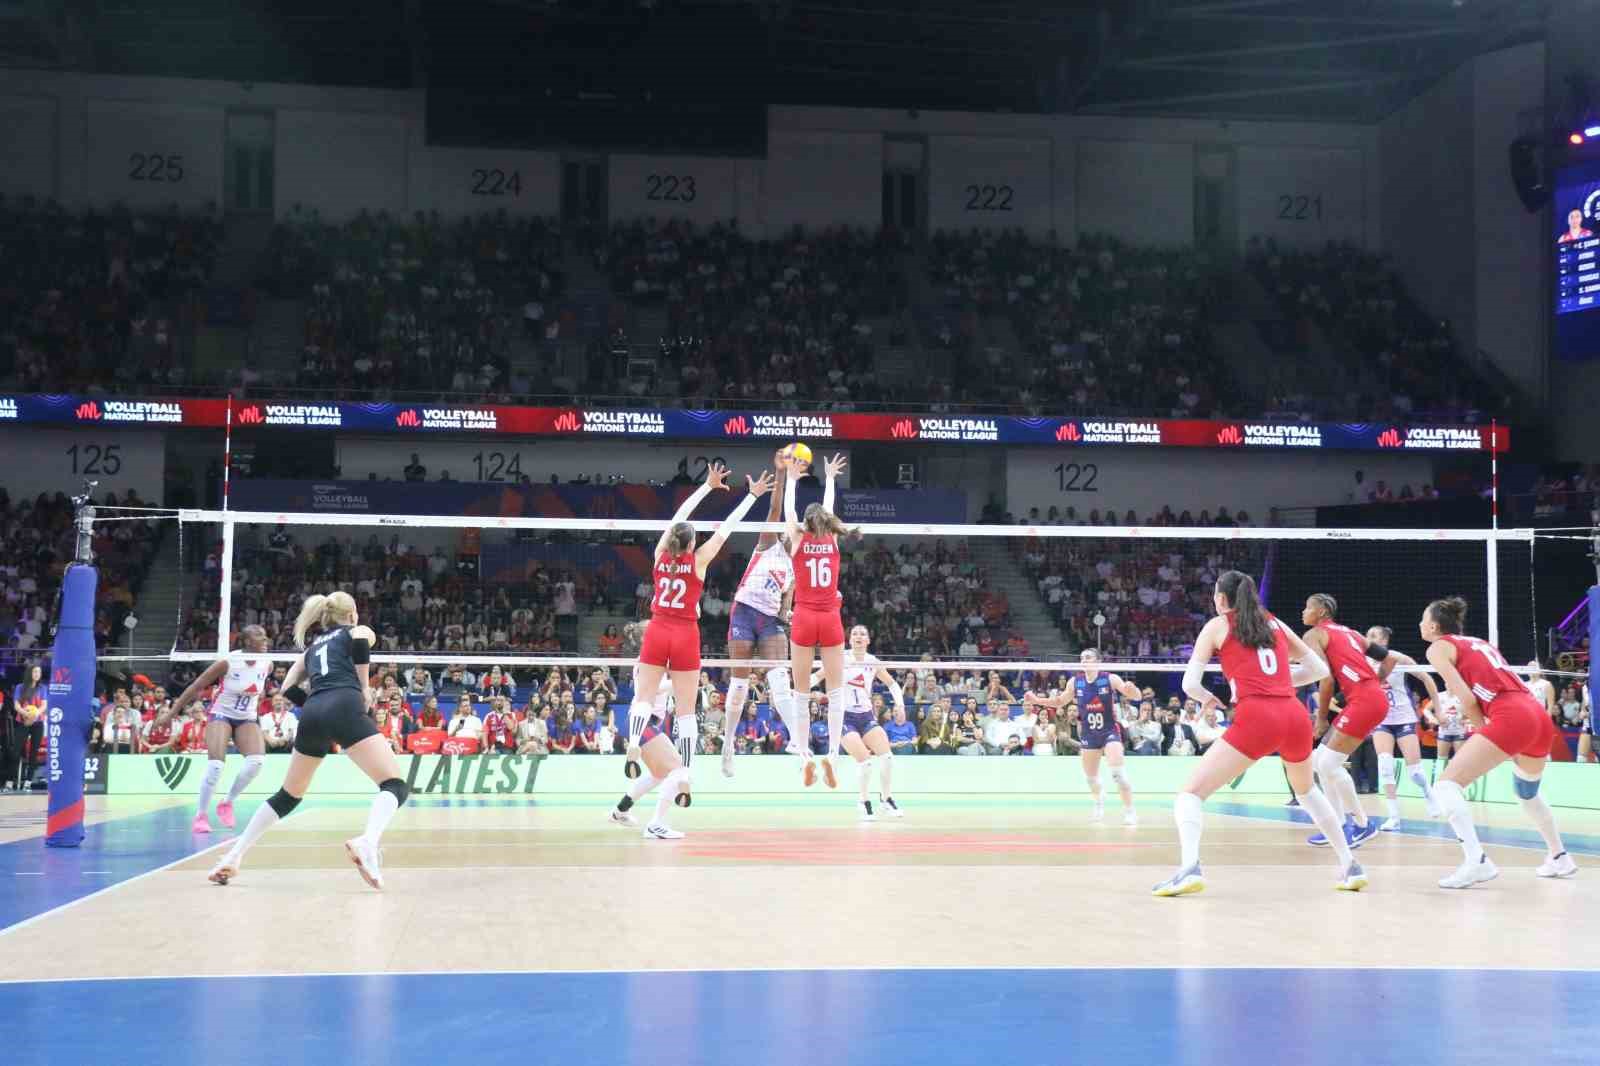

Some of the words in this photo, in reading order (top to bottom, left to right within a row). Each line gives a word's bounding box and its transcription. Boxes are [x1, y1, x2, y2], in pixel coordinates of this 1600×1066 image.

[129, 153, 184, 182] 225
[471, 169, 521, 197] 224
[647, 175, 697, 202] 223
[965, 184, 1015, 211] 222
[1279, 194, 1323, 219] 221
[104, 402, 182, 414] VOLLEYBALL
[266, 406, 341, 418] VOLLEYBALL
[104, 412, 144, 421] NATIONS
[147, 413, 182, 422] LEAGUE
[266, 415, 304, 424] NATIONS
[307, 416, 341, 425] LEAGUE
[423, 410, 496, 422] VOLLEYBALL
[584, 412, 664, 424] VOLLEYBALL
[753, 416, 832, 428] VOLLEYBALL
[423, 418, 461, 427] NATIONS
[464, 419, 496, 428] LEAGUE
[584, 423, 625, 432] NATIONS
[628, 424, 664, 433] LEAGUE
[919, 419, 997, 431] VOLLEYBALL
[1083, 423, 1160, 435] VOLLEYBALL
[753, 426, 793, 435] NATIONS
[797, 427, 832, 436] LEAGUE
[919, 430, 959, 439] NATIONS
[962, 431, 997, 440] LEAGUE
[1083, 432, 1123, 441] NATIONS
[1126, 433, 1160, 442] LEAGUE
[1245, 425, 1321, 437] VOLLEYBALL
[1405, 429, 1480, 441] VOLLEYBALL
[1245, 436, 1284, 445] NATIONS
[1287, 437, 1321, 446] LEAGUE
[1405, 438, 1444, 447] NATIONS
[1446, 439, 1480, 448] LEAGUE
[67, 445, 121, 475] 125
[474, 451, 522, 481] 124
[1055, 463, 1098, 492] 122
[805, 558, 832, 588] 16
[658, 577, 687, 609] 22
[315, 643, 329, 677] 1
[234, 694, 251, 712] 19
[1088, 713, 1105, 730] 99
[50, 724, 63, 782] Senoh
[407, 754, 548, 794] LATEST
